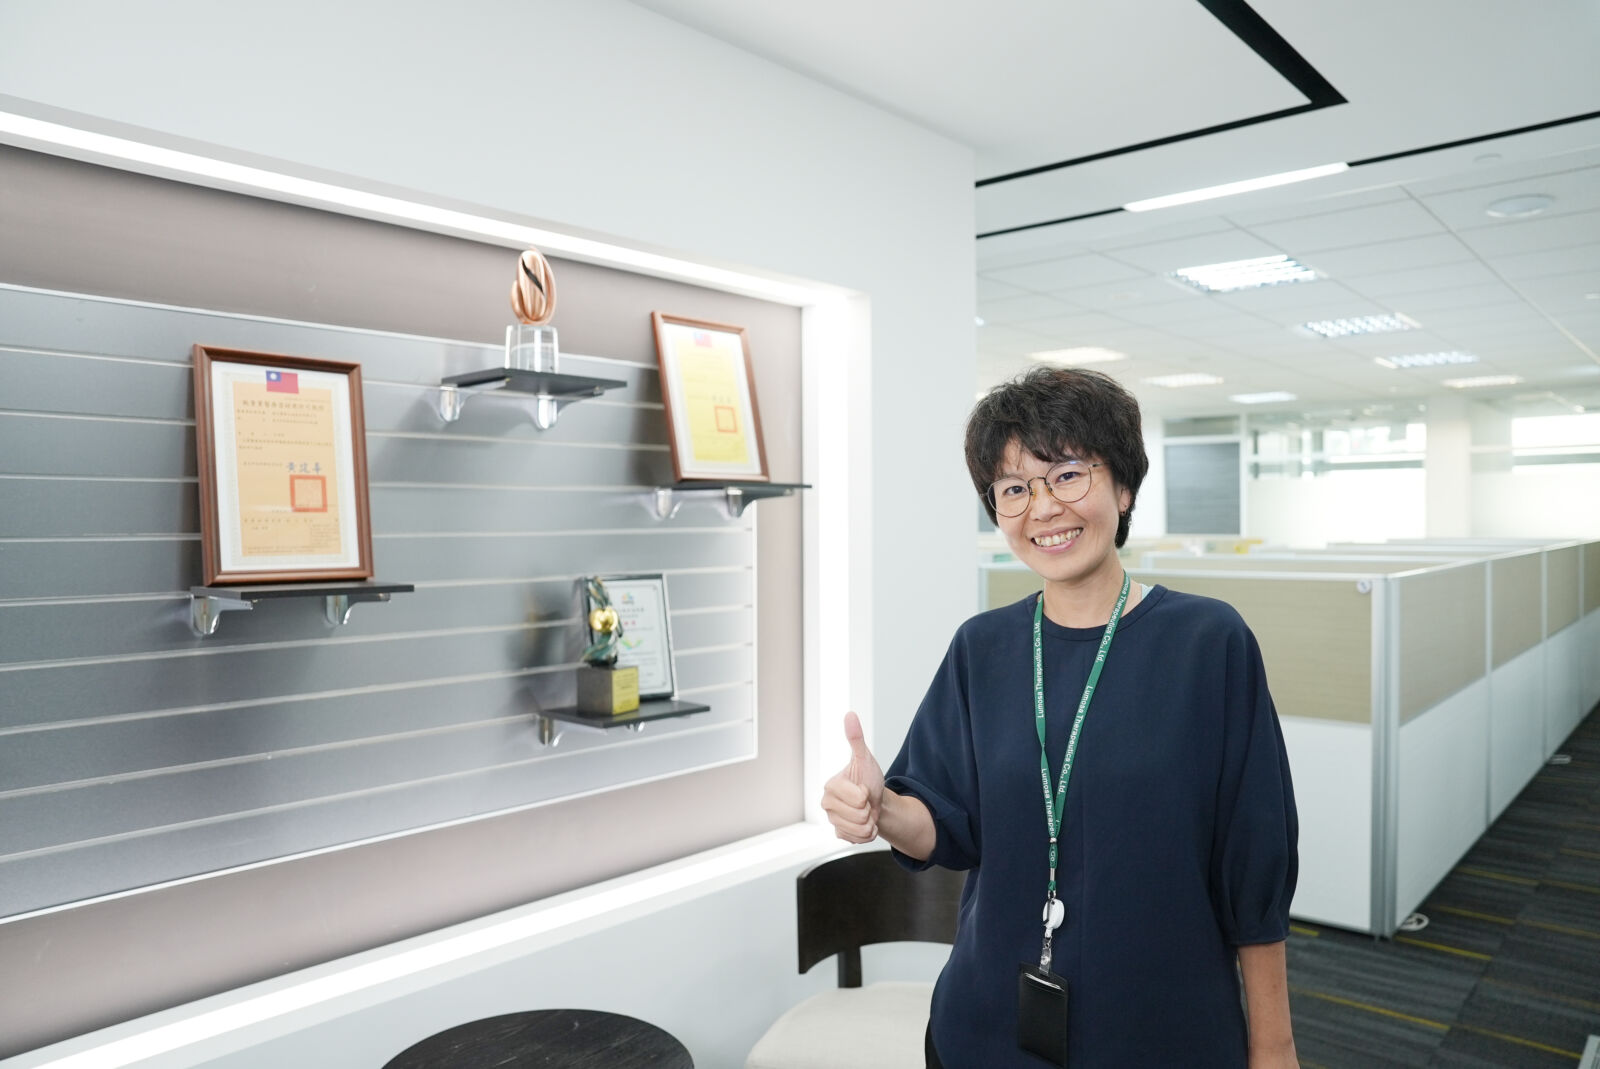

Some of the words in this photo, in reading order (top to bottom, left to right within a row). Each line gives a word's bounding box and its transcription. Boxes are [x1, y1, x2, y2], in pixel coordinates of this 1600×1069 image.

[1105, 595, 1127, 634] Therapeutics
[1037, 691, 1045, 718] Lumosa
[1078, 685, 1094, 713] Lumosa
[1065, 715, 1084, 762] Therapeutics
[1041, 768, 1051, 798] Lumosa
[1046, 800, 1056, 838] Therapeu
